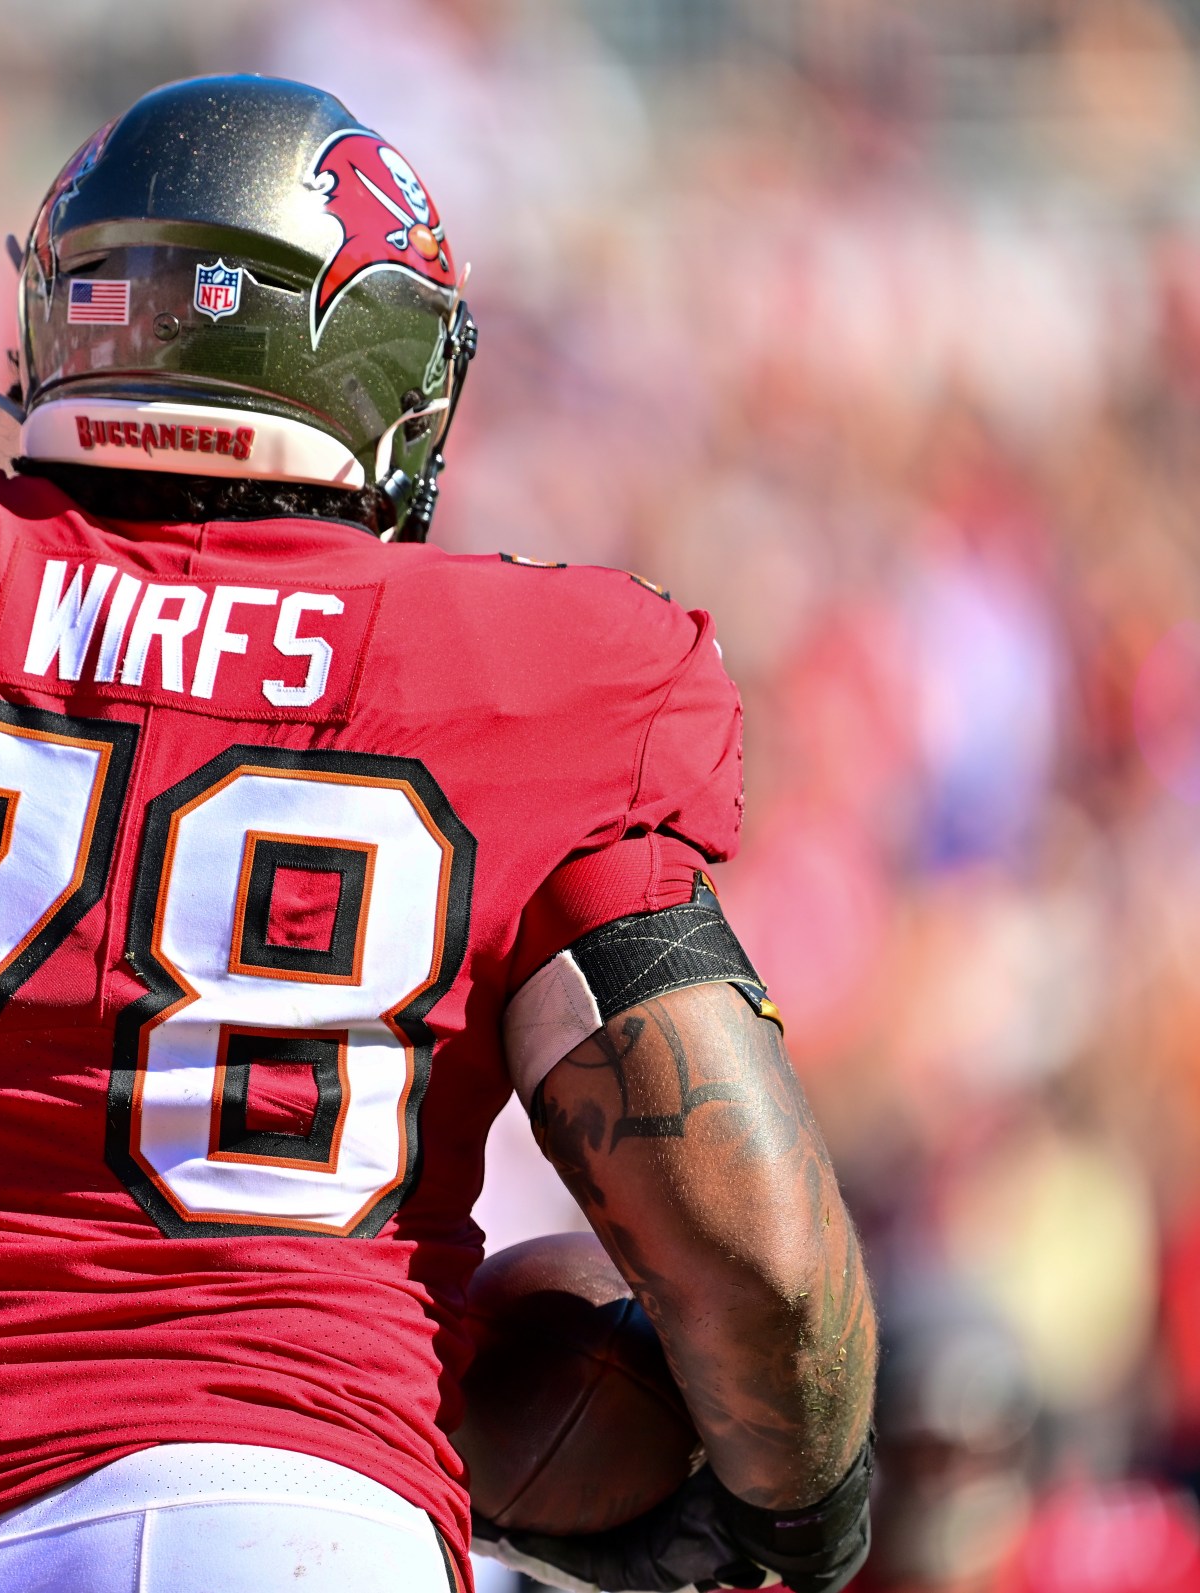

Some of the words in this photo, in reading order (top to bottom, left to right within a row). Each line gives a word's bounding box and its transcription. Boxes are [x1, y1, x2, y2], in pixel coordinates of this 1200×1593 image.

[200, 286, 233, 310] NFL
[75, 415, 255, 460] BUCCANEERS
[23, 559, 345, 707] WIRFS
